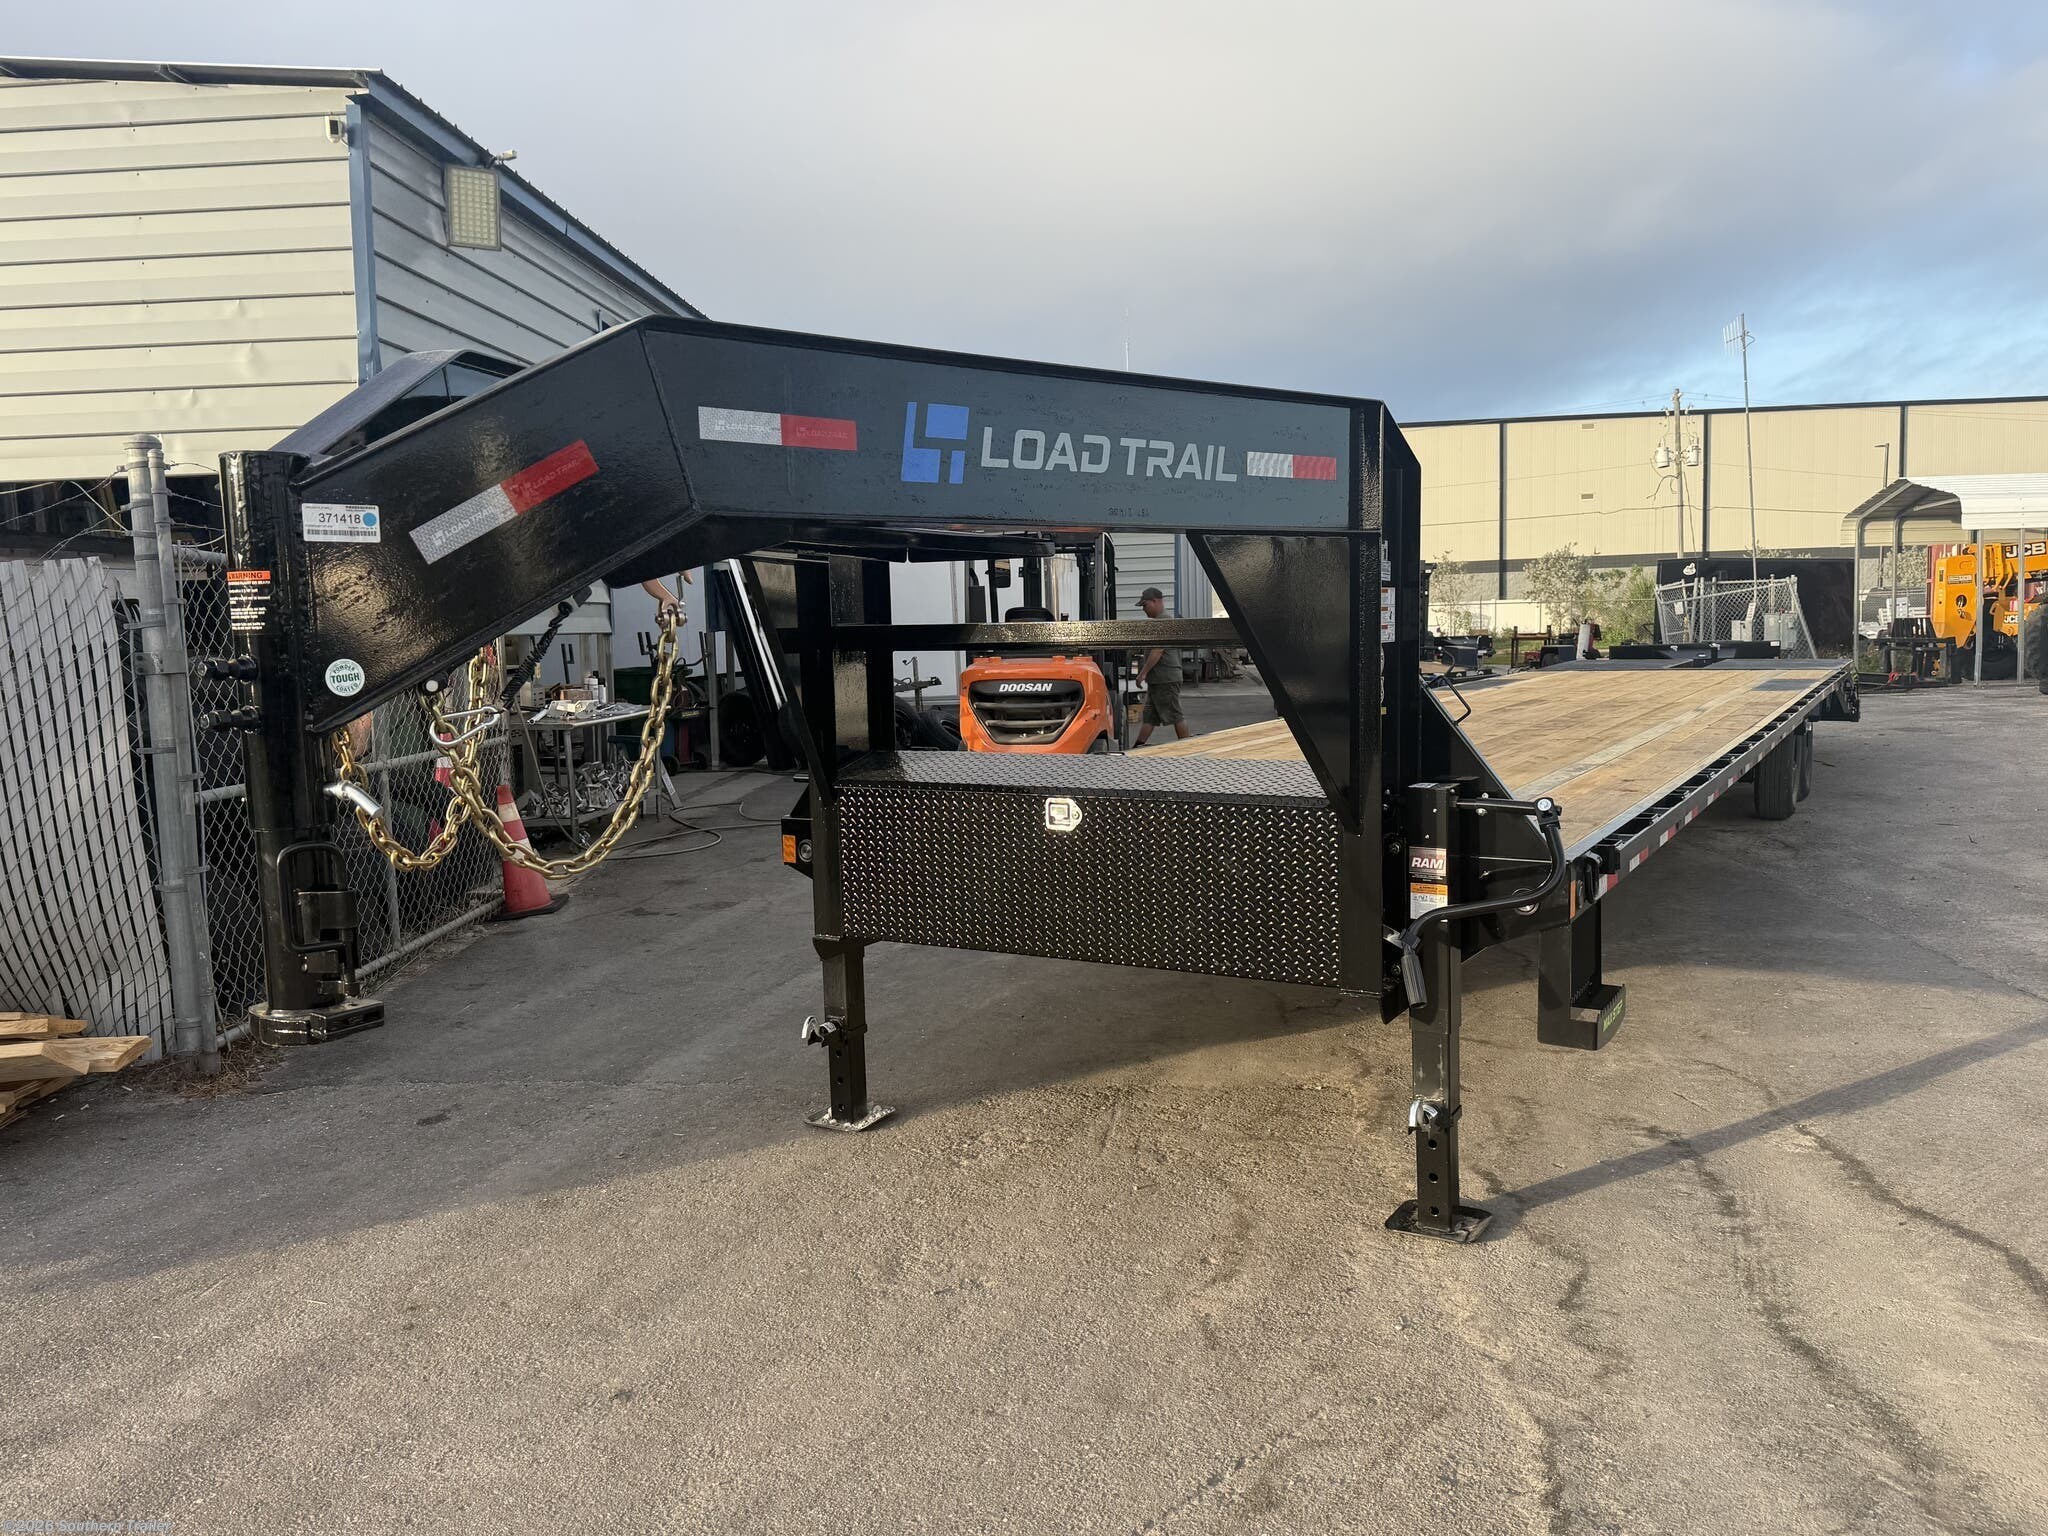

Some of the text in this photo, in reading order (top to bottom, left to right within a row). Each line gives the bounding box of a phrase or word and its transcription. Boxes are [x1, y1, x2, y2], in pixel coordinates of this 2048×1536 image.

[981, 426, 1237, 482] LOAD TRAIL
[319, 512, 361, 524] 371418
[2005, 543, 2046, 558] JCB
[330, 672, 360, 684] TOUGH
[999, 683, 1053, 692] DOOSAN
[1411, 856, 1444, 870] RAM
